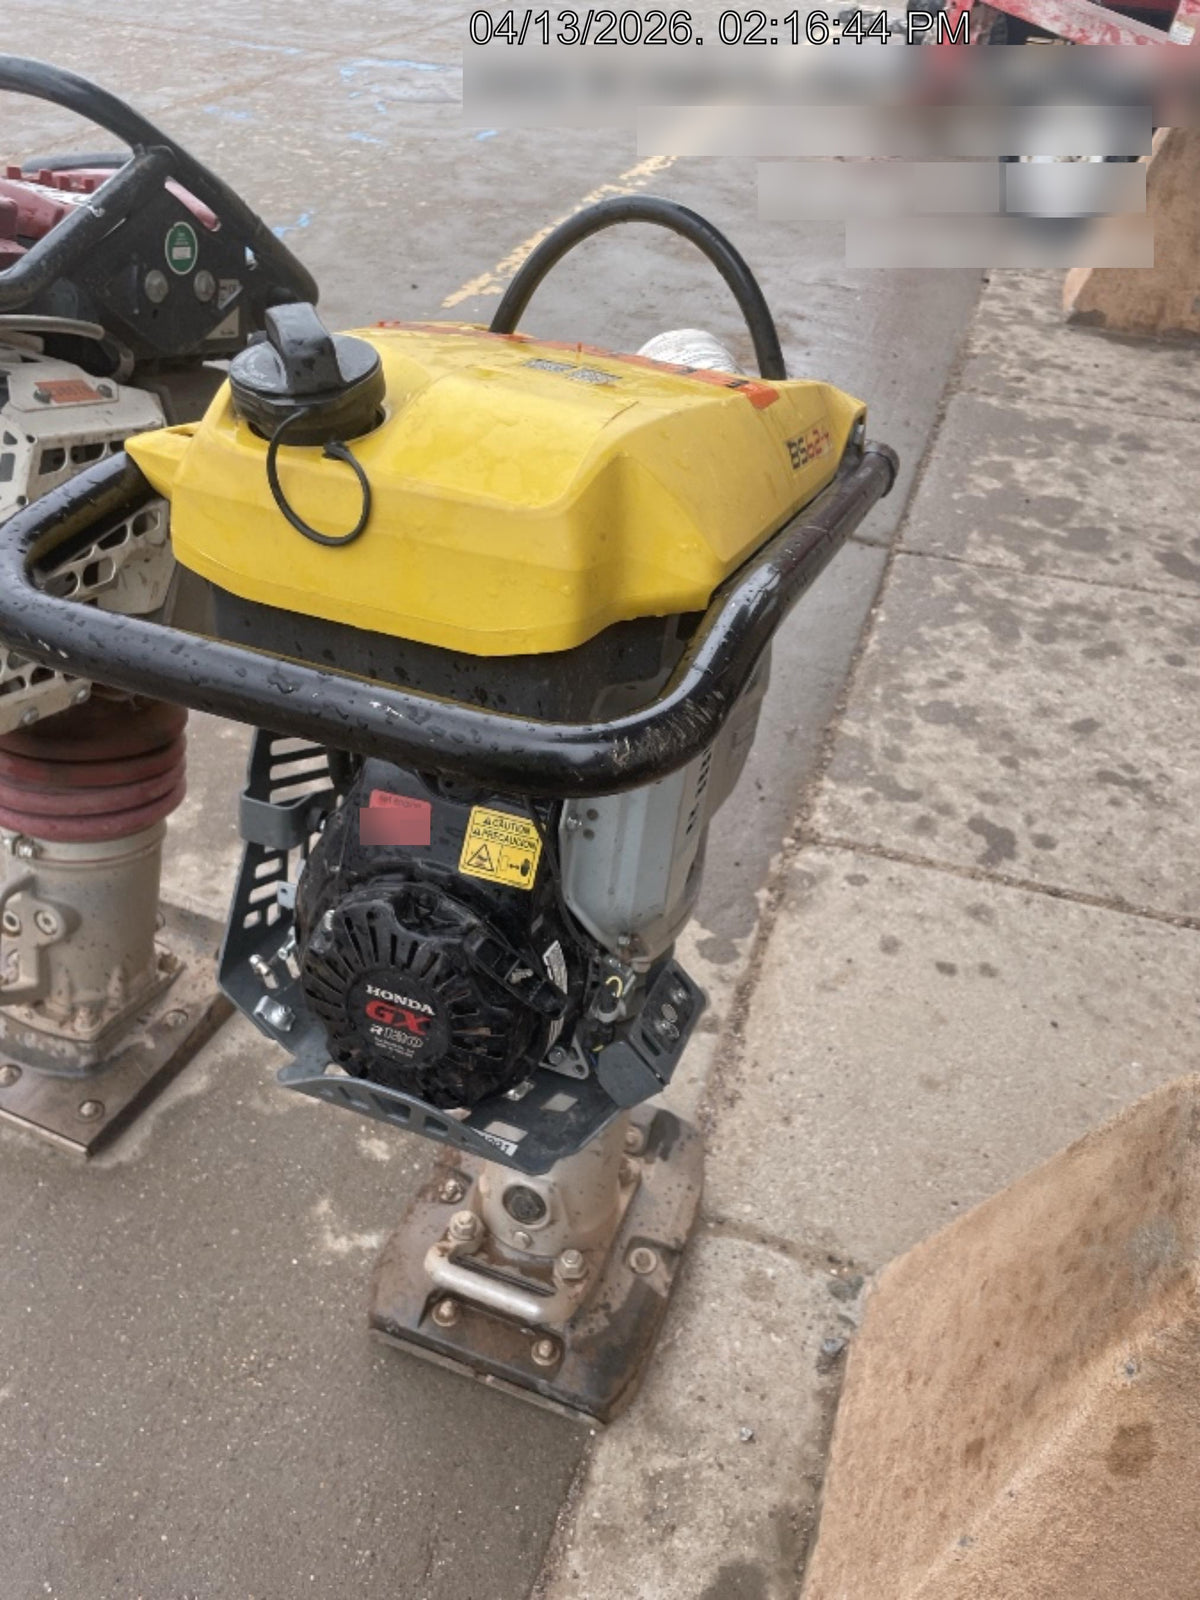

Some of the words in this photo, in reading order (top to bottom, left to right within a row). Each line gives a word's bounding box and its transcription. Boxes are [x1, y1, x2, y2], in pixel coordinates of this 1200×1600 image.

[492, 818, 531, 835] CAUTION
[365, 984, 435, 1016] HONDA
[365, 1000, 432, 1036] GX
